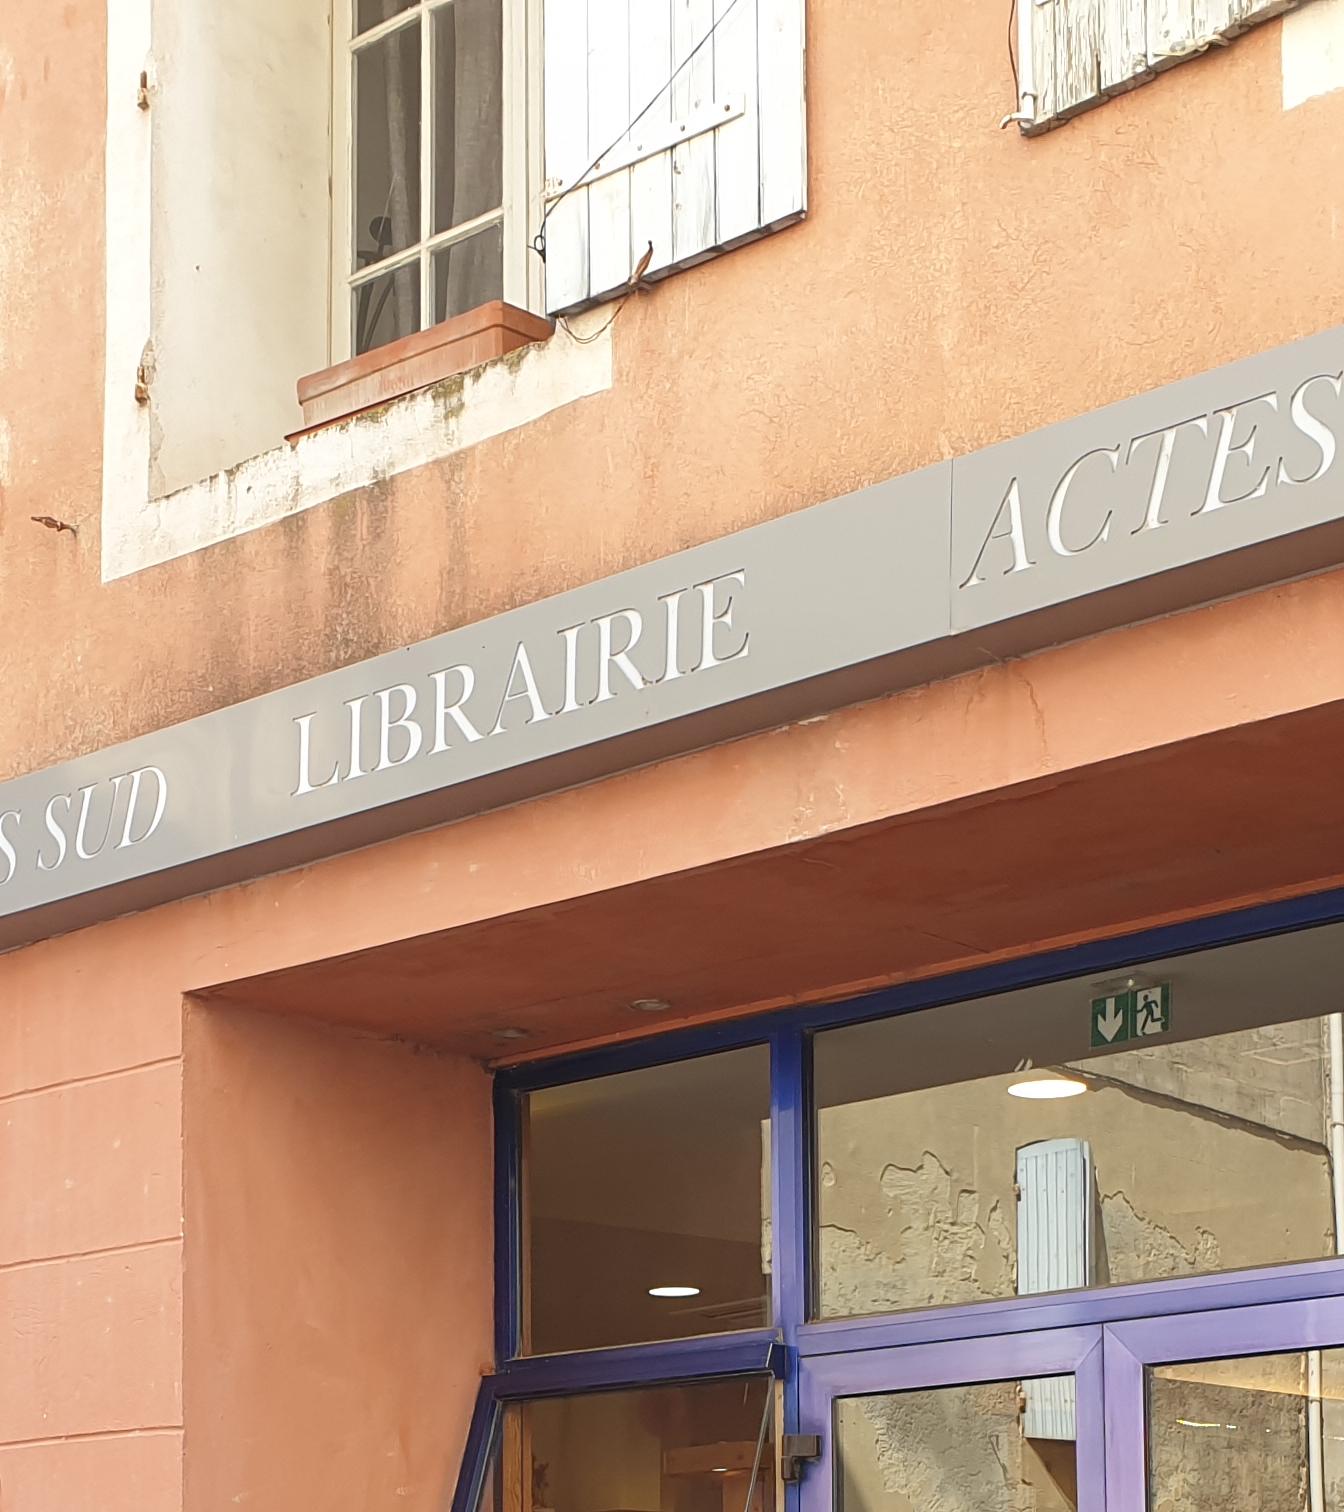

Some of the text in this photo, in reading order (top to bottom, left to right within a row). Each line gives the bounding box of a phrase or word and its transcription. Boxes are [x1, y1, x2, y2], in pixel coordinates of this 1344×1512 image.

[960, 371, 1344, 590] ACTES
[291, 569, 752, 798] LIBRAIRIE
[36, 765, 169, 873] SUD
